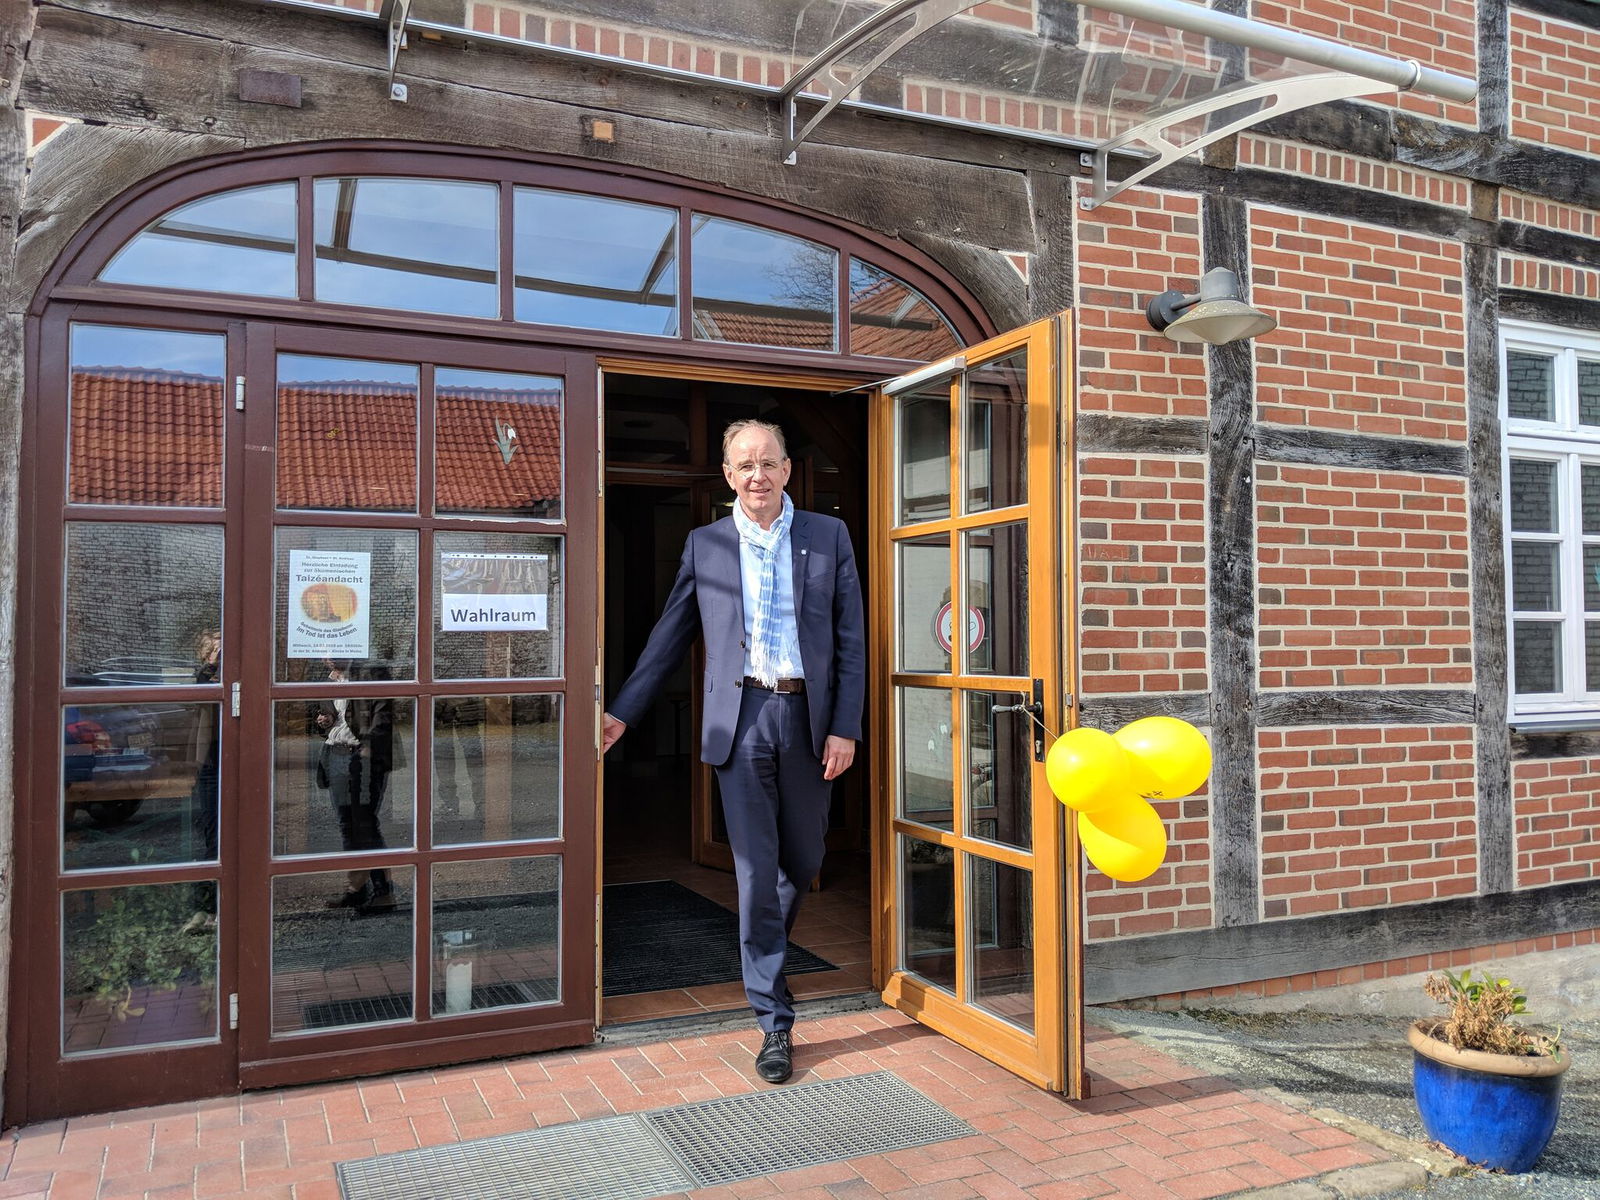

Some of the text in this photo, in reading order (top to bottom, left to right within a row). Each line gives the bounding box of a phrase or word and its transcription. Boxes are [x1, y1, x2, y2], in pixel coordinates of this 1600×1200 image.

[296, 574, 363, 584] Taizéandacht
[451, 608, 536, 622] Wahlraum
[297, 625, 305, 634] Im
[306, 629, 317, 637] Tod
[339, 626, 358, 637] Leben
